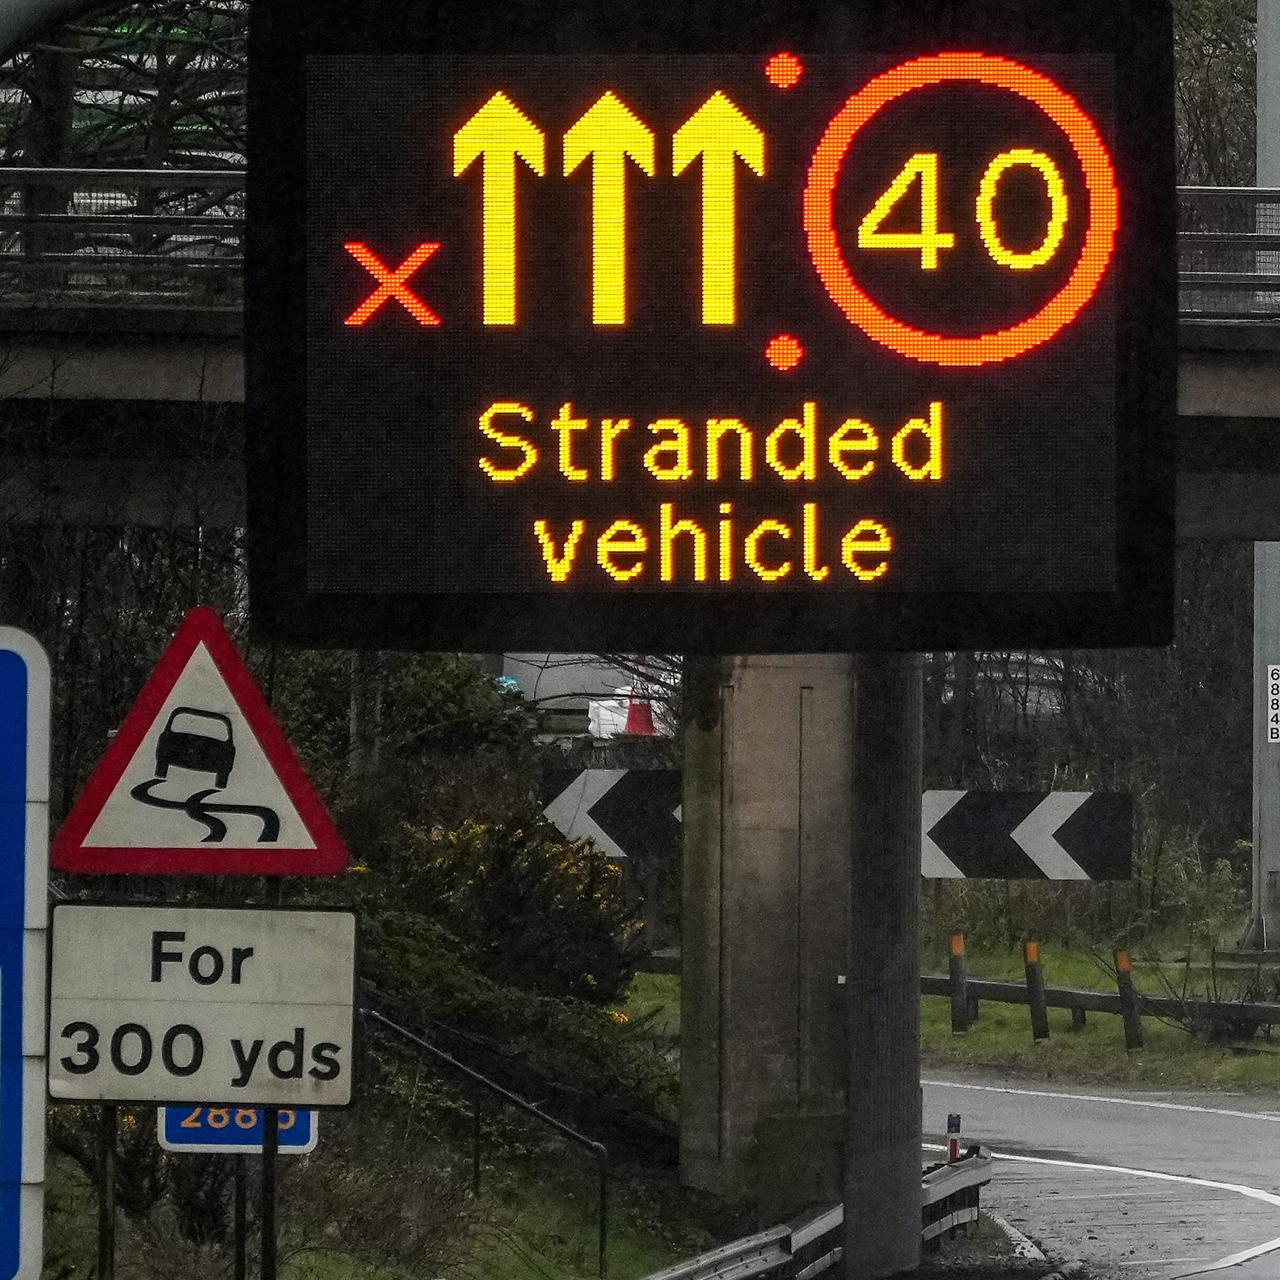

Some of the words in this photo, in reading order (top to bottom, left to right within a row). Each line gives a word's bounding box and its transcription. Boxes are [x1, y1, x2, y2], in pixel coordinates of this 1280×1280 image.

[857, 148, 1069, 270] 40
[478, 401, 943, 481] Stranded
[533, 502, 894, 582] vehicle
[1270, 667, 1280, 740] 6884B
[150, 930, 255, 985] For
[59, 1021, 205, 1077] 300
[229, 1027, 343, 1088] yds
